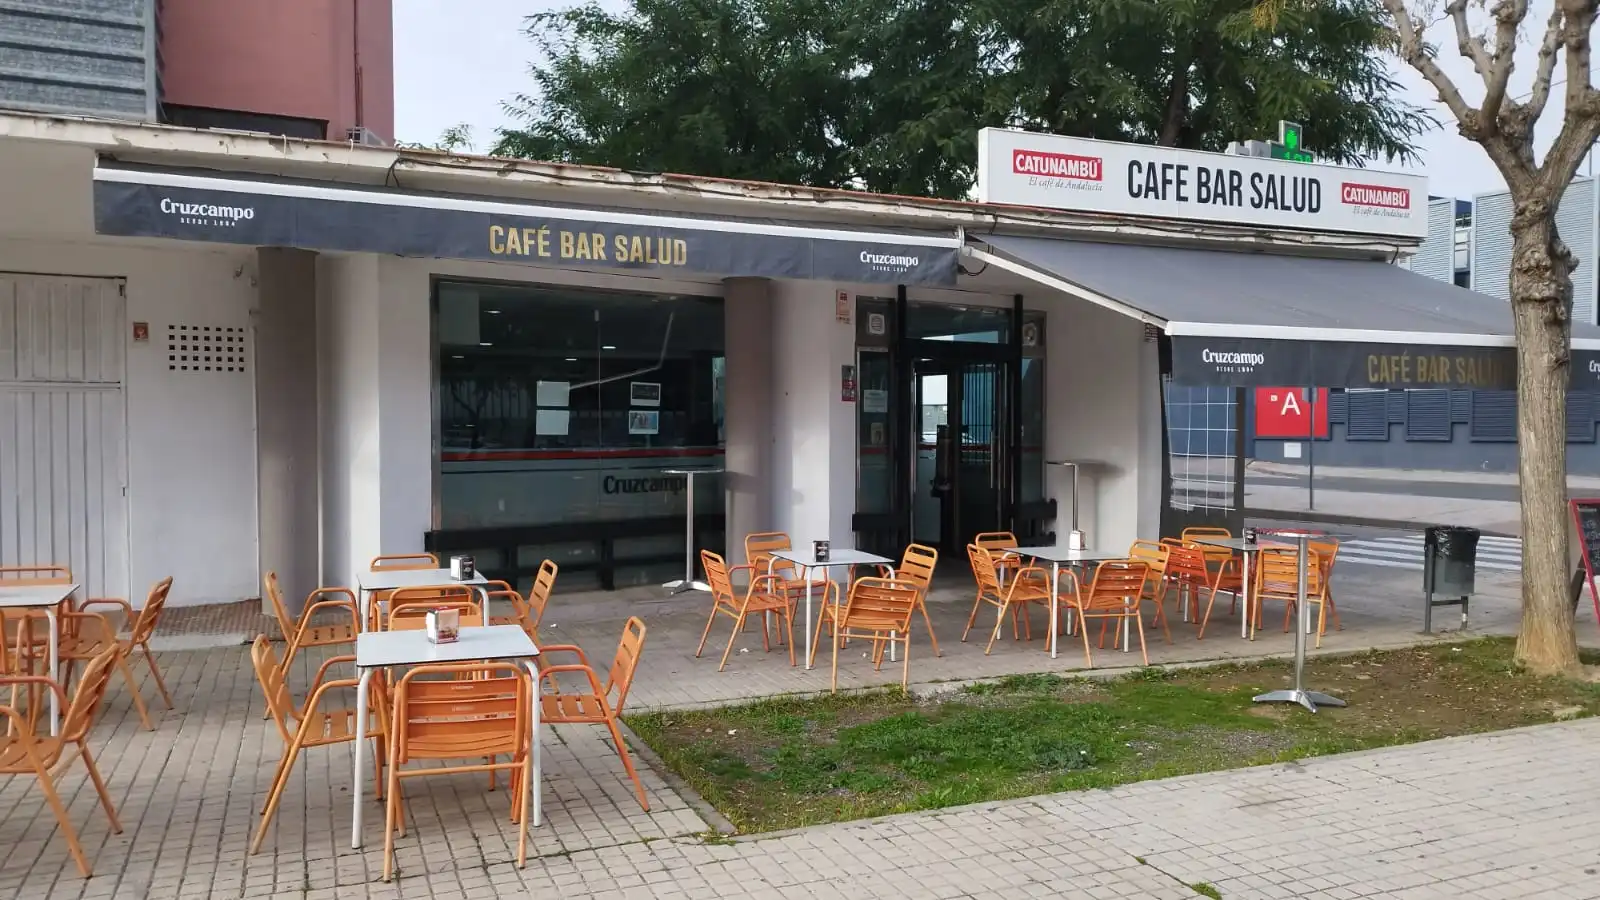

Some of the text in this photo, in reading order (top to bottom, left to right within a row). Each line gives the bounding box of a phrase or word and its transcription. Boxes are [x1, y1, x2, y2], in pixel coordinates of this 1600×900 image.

[1028, 177, 1037, 186] El
[1127, 160, 1321, 214] CAFE BAR SALUD
[160, 198, 254, 221] Cruzcampo
[489, 225, 687, 266] CAFÉ BAR SALUD
[860, 250, 919, 268] Cruzcampo
[1202, 348, 1265, 366] Cruzcampo
[1367, 350, 1505, 388] CAFÉ BAR SALU
[1281, 391, 1301, 416] A
[603, 475, 687, 496] Cruzcamp
